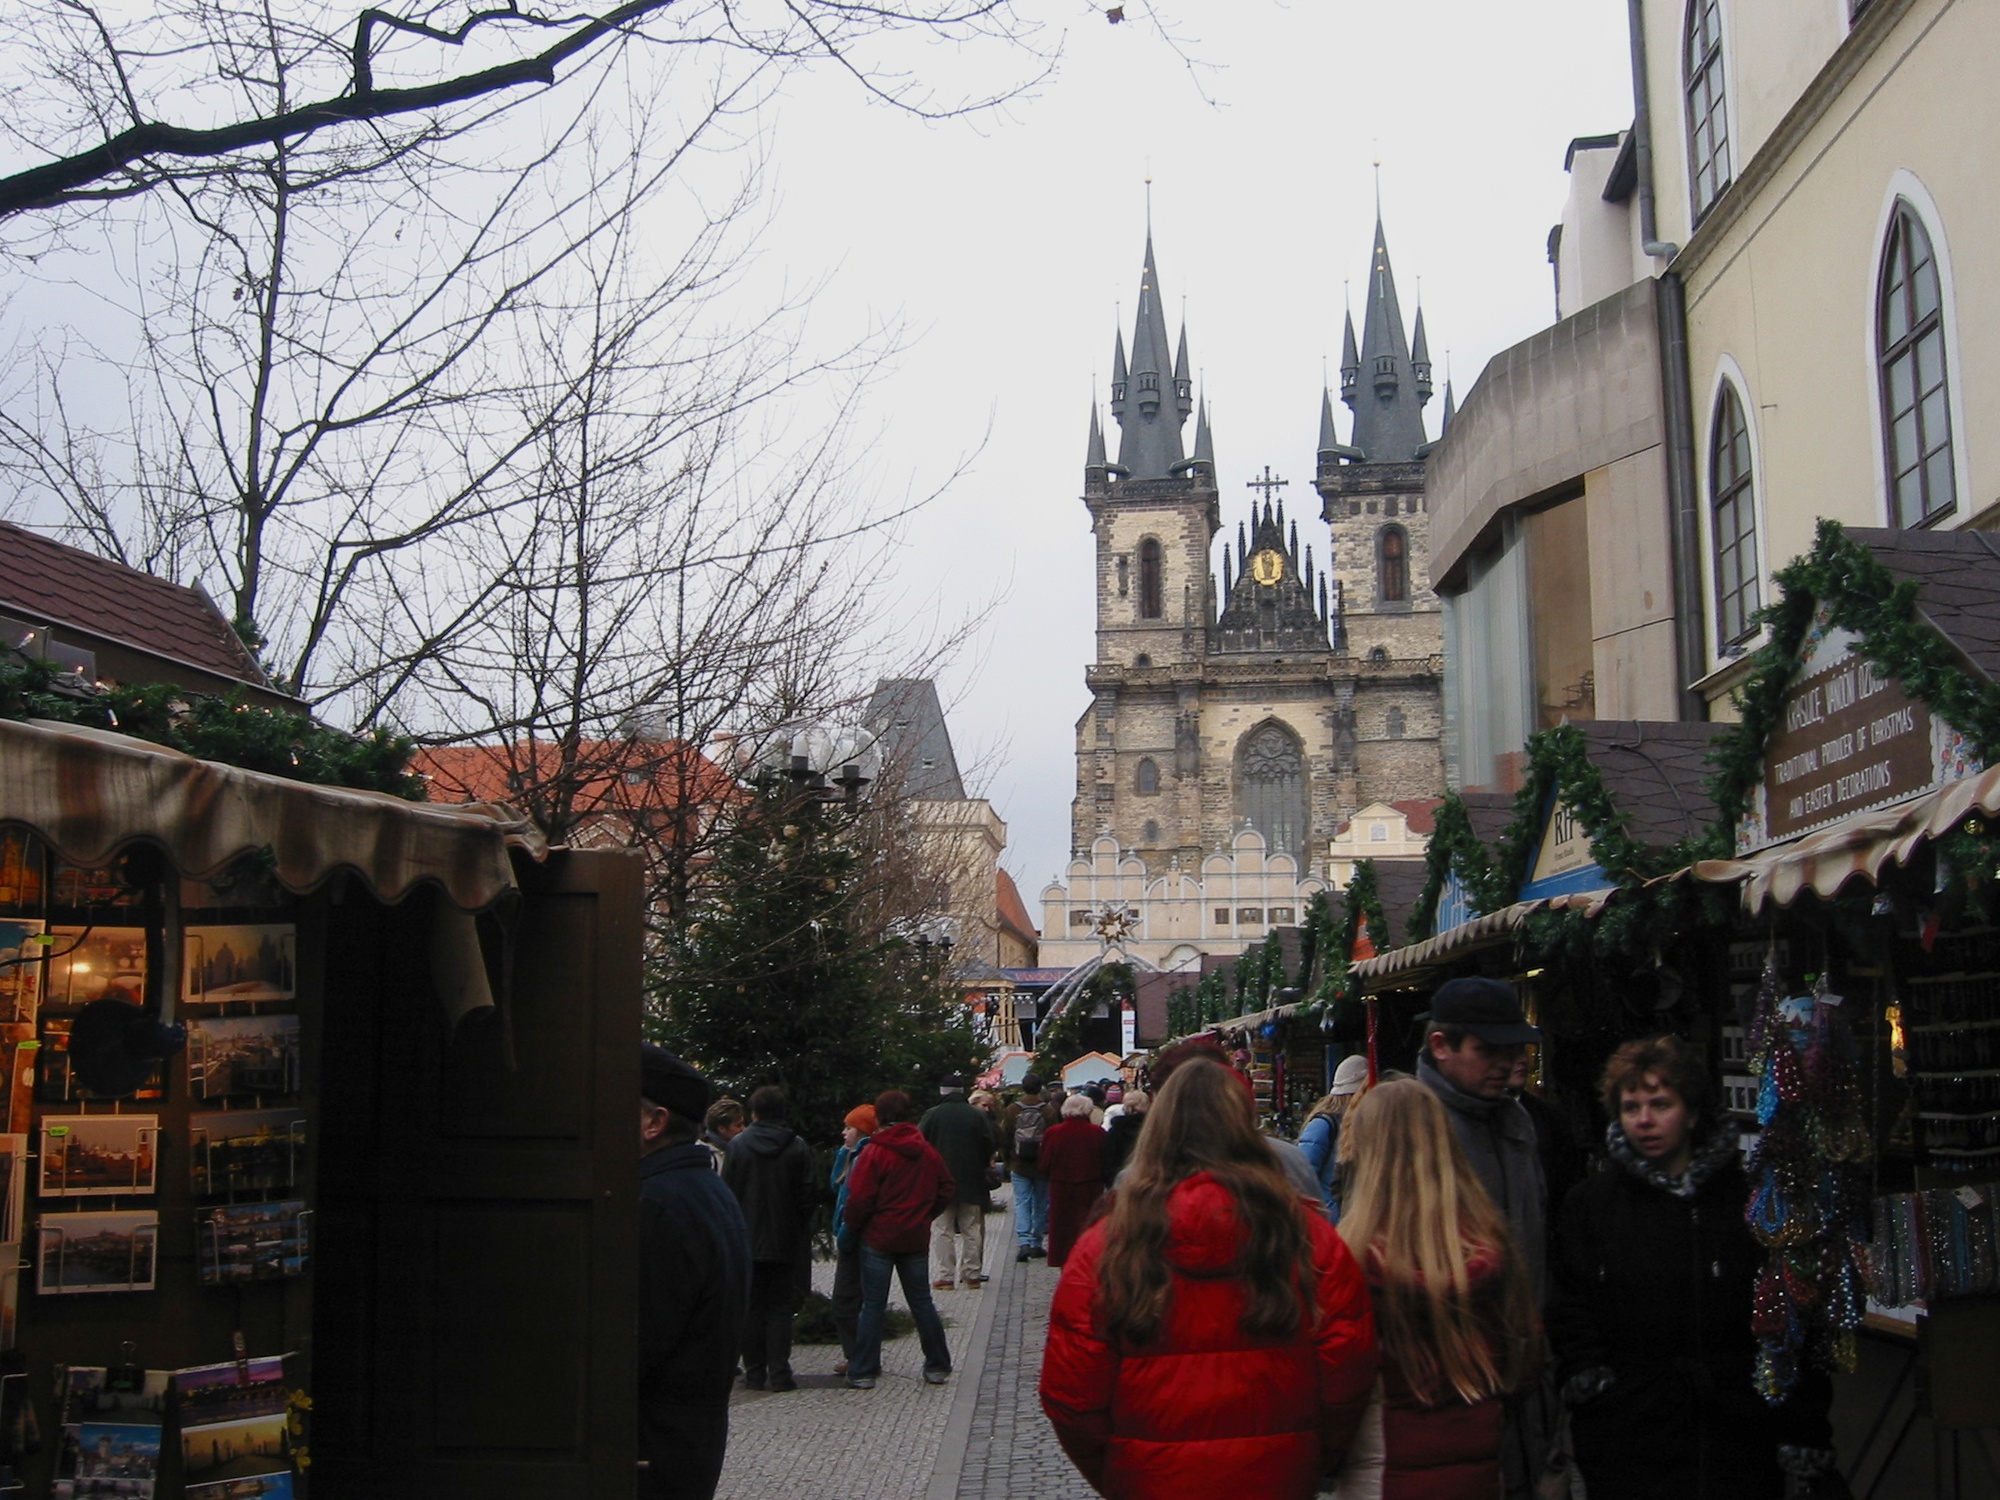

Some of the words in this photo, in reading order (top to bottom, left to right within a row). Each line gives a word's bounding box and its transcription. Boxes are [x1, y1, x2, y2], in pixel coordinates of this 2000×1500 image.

[1774, 750, 1818, 785] TRADITIONAL
[1822, 733, 1853, 766] PRODUCER
[1856, 725, 1867, 752] OF
[1871, 706, 1913, 745] CHRISTMAS
[1790, 796, 1803, 819] AND
[1805, 783, 1833, 814] EASTER
[1836, 760, 1890, 801] DECORATIONS
